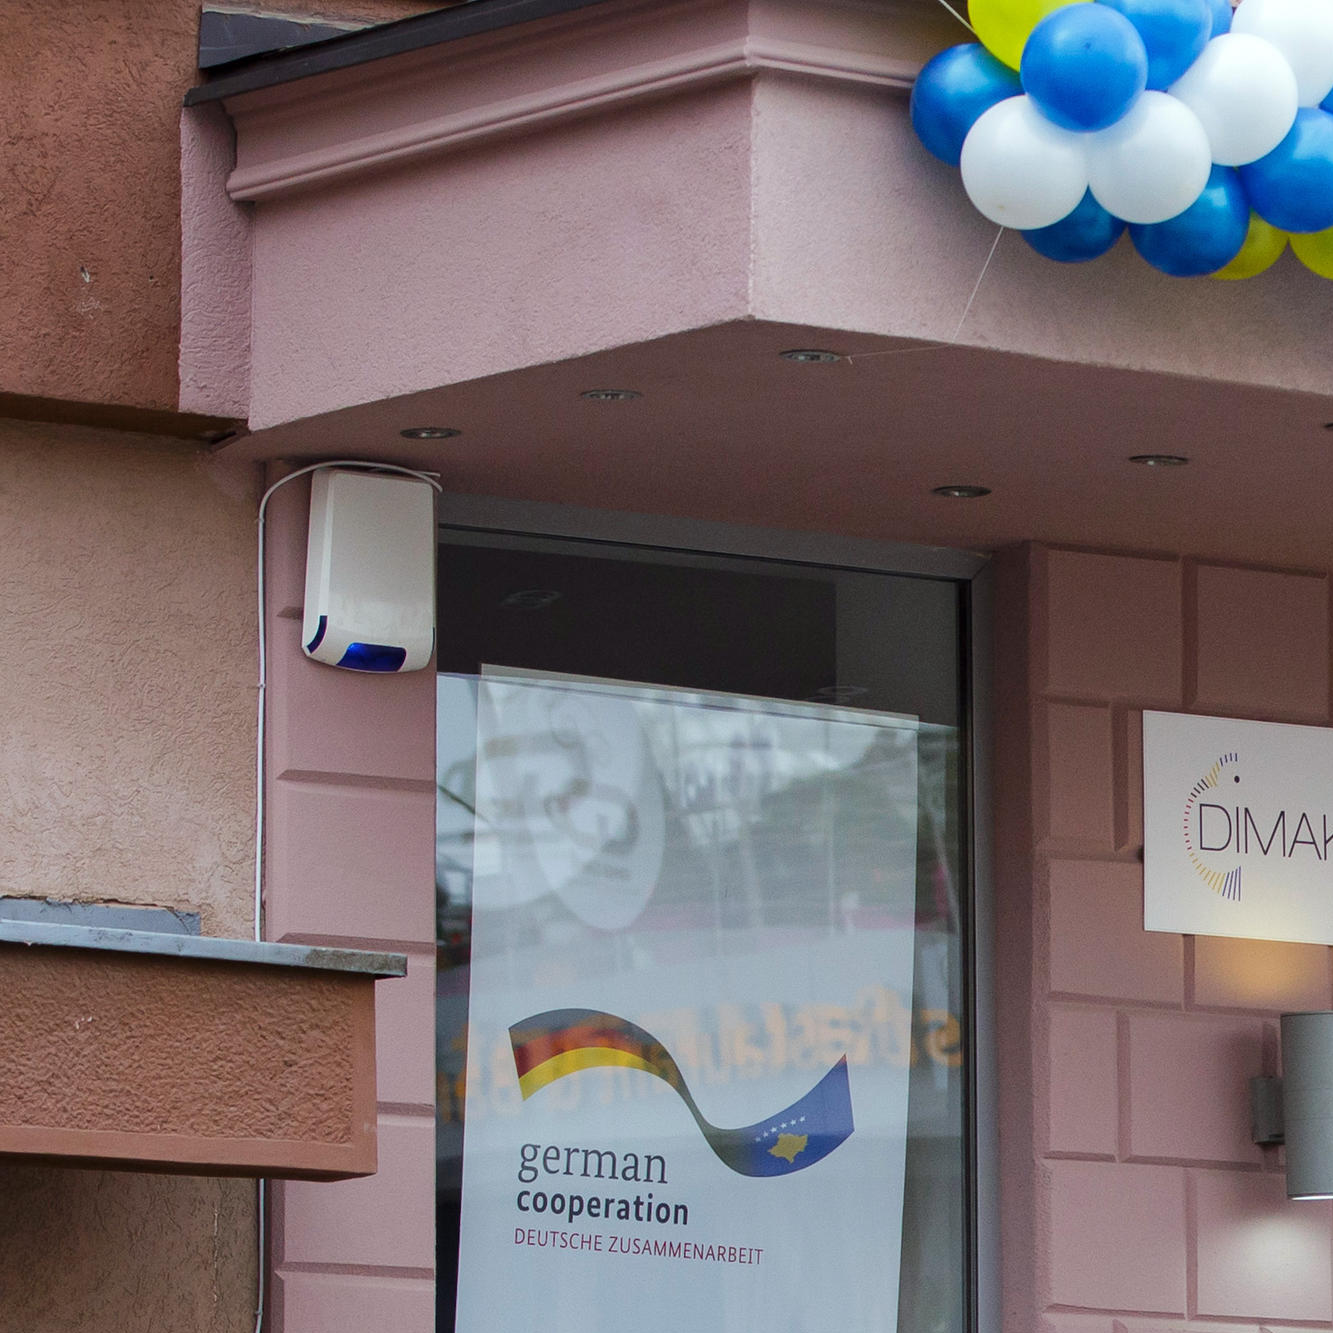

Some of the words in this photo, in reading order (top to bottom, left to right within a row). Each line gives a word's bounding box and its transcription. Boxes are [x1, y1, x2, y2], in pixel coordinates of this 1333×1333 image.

[517, 1143, 668, 1184] german
[516, 1190, 689, 1225] cooperation
[514, 1227, 603, 1252] DEUTSCHE
[608, 1236, 764, 1265] ZUSAMMENARBEIT
